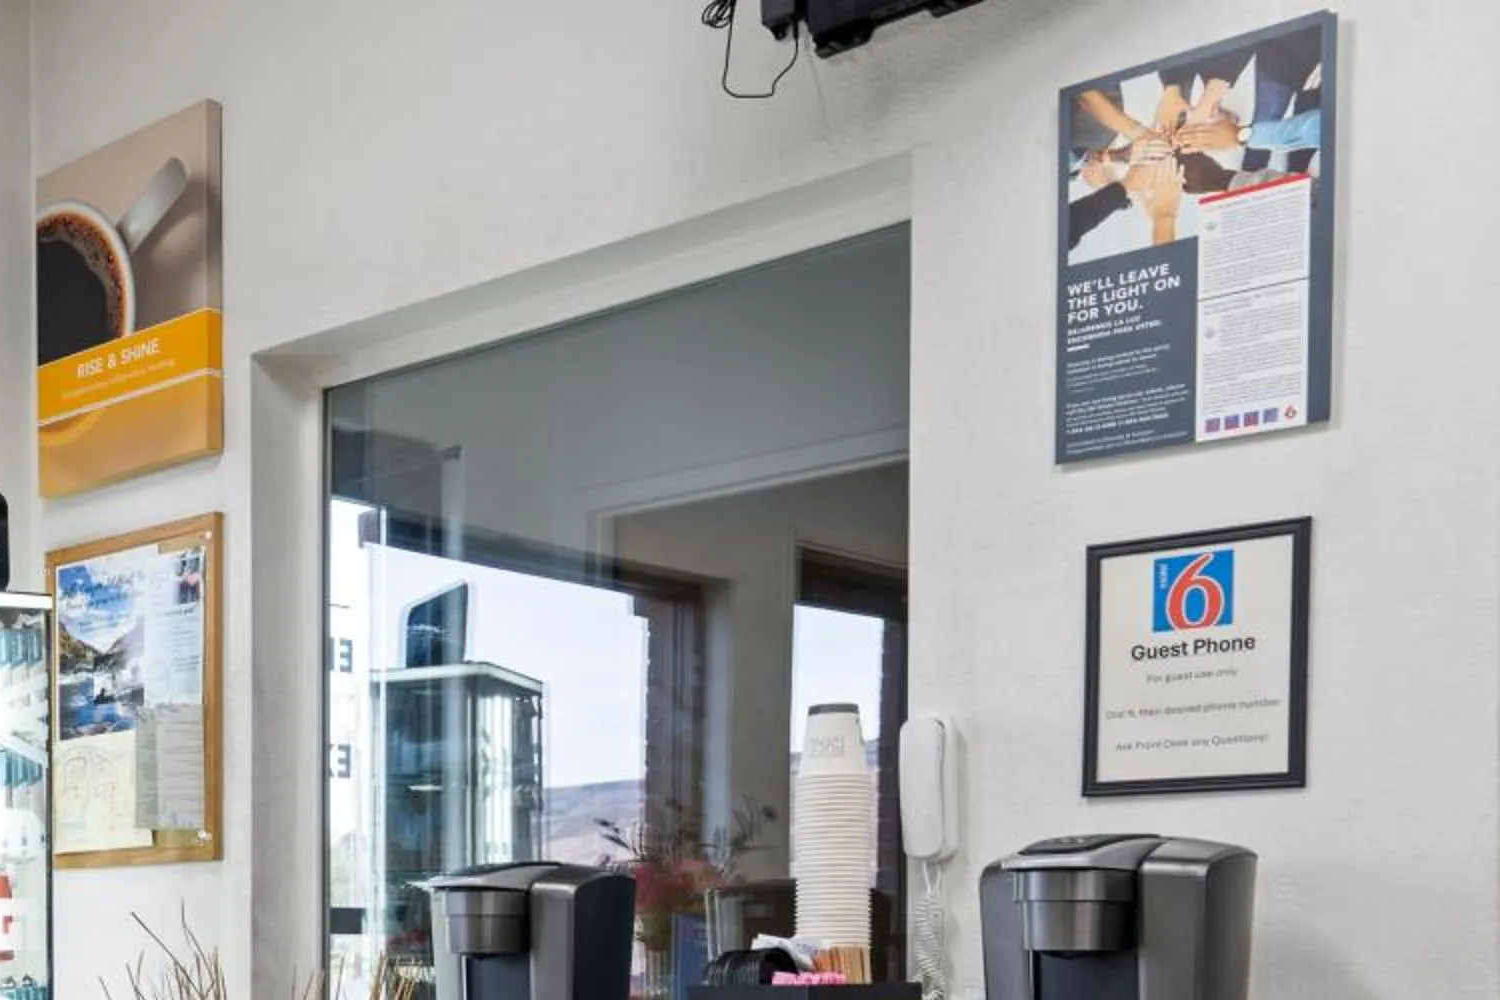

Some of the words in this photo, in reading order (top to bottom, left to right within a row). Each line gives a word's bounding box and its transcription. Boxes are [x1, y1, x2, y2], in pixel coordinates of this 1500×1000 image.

[1067, 277, 1114, 297] WE'LL
[1119, 264, 1170, 285] LEAVE
[1067, 294, 1097, 311] THE
[1103, 282, 1150, 303] LIGHT
[1154, 275, 1181, 292] ON
[1067, 308, 1099, 325] FOR
[1104, 299, 1144, 317] YOU.
[77, 357, 104, 379] RISE
[107, 353, 117, 369] &
[120, 337, 161, 365] SHINE
[1166, 552, 1225, 632] 6
[1131, 642, 1189, 661] Guest
[1193, 636, 1256, 656] Phone
